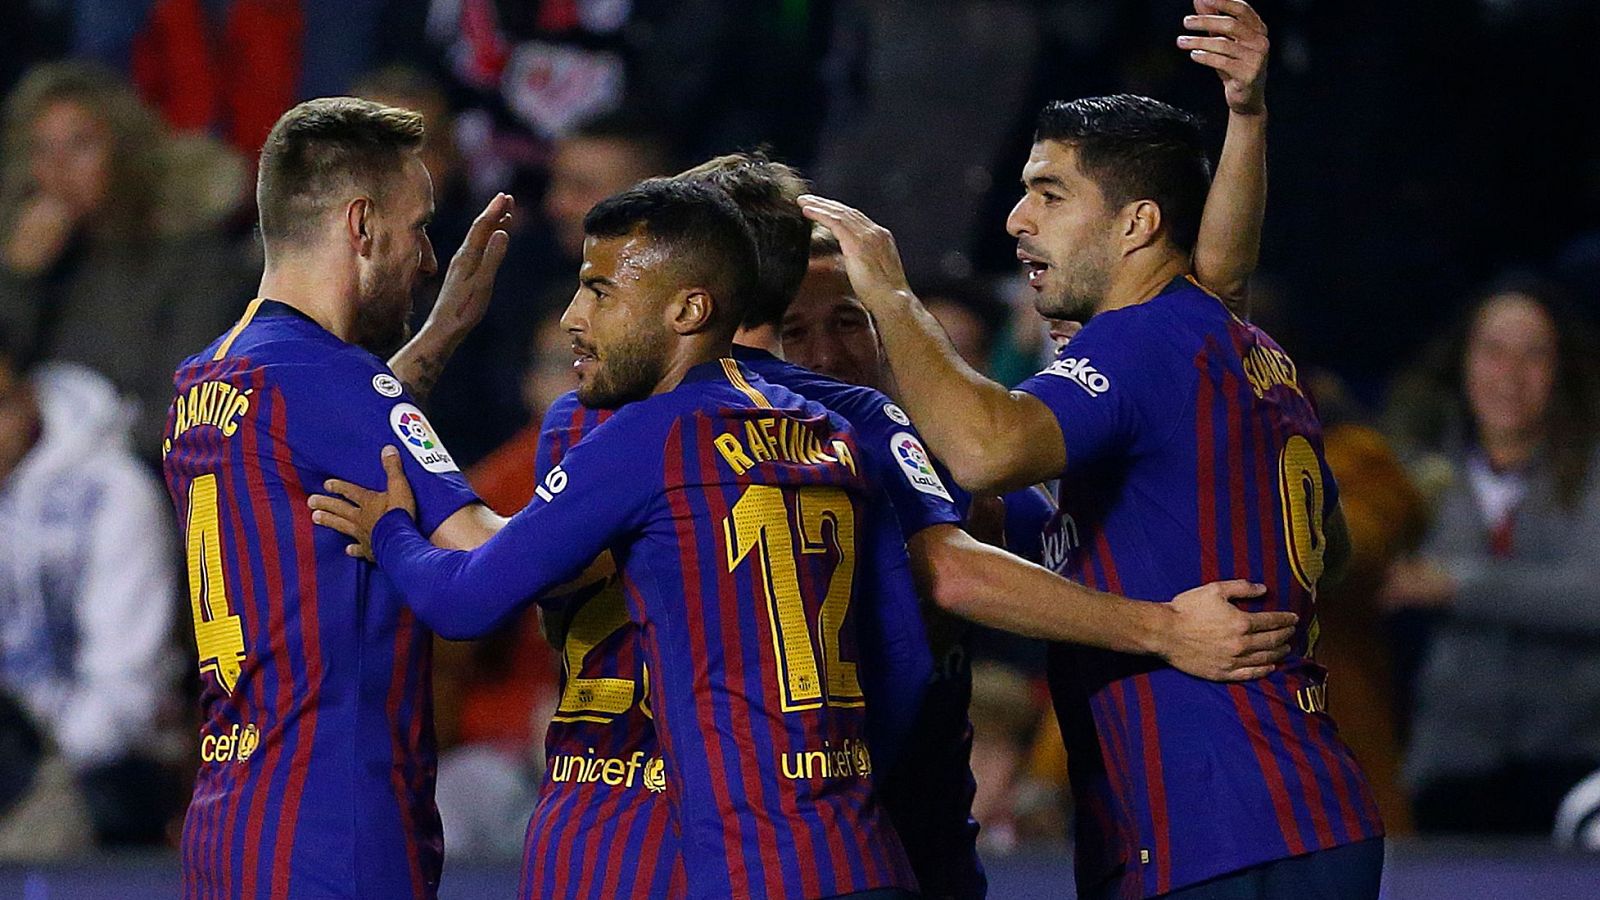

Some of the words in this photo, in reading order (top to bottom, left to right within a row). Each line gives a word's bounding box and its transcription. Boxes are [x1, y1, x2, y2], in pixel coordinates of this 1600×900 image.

[174, 381, 253, 437] RAKITIĆ
[187, 473, 247, 697] 4
[723, 484, 866, 713] 12
[551, 578, 653, 723] 2
[552, 748, 645, 788] unicef
[782, 738, 853, 779] unicef
